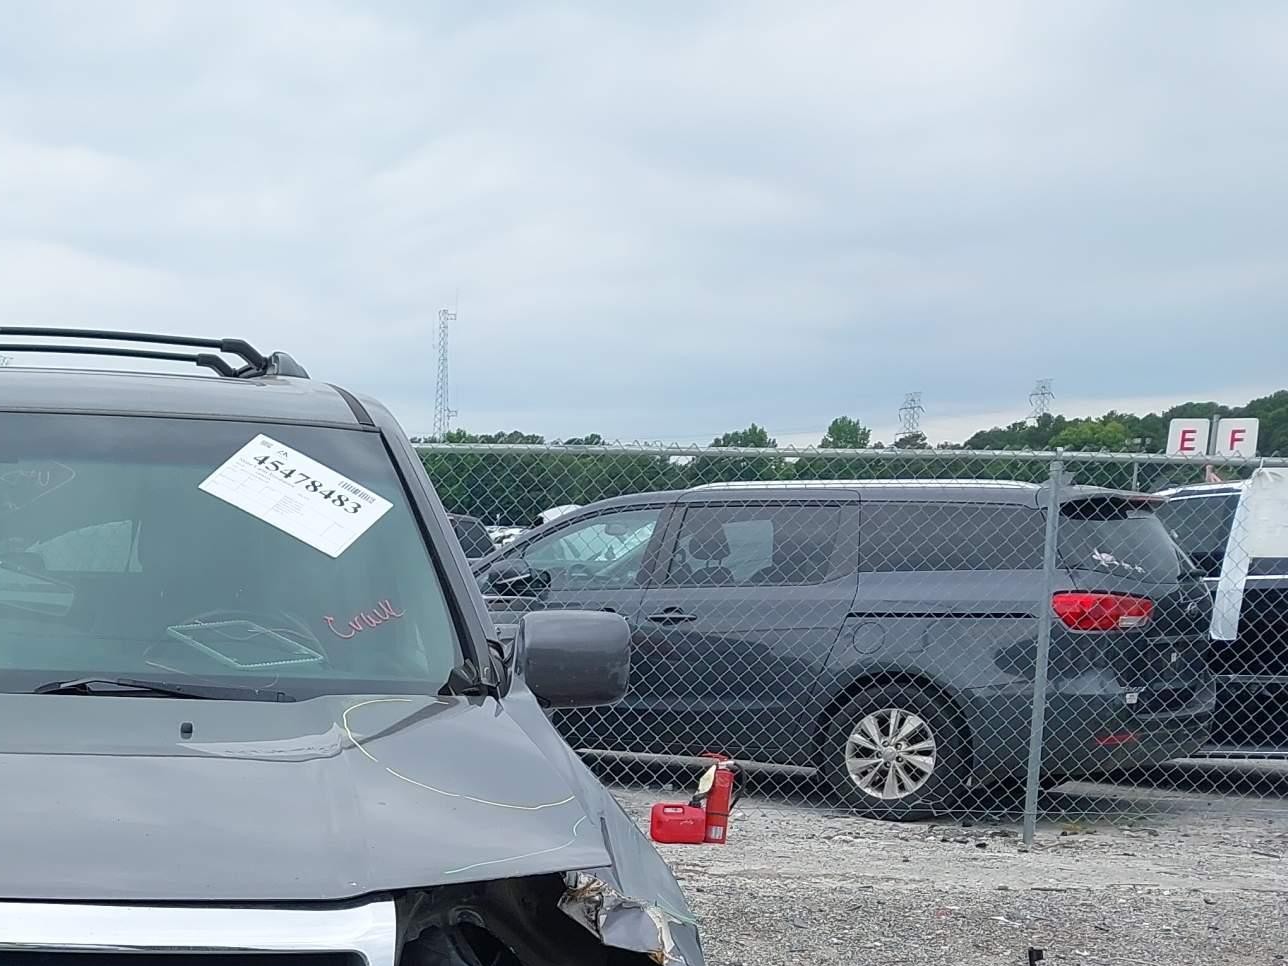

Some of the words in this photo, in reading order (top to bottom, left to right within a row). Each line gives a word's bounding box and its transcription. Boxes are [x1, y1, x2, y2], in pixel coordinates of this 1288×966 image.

[1179, 429, 1197, 451] E
[1229, 429, 1247, 451] F
[253, 455, 362, 514] 45478483
